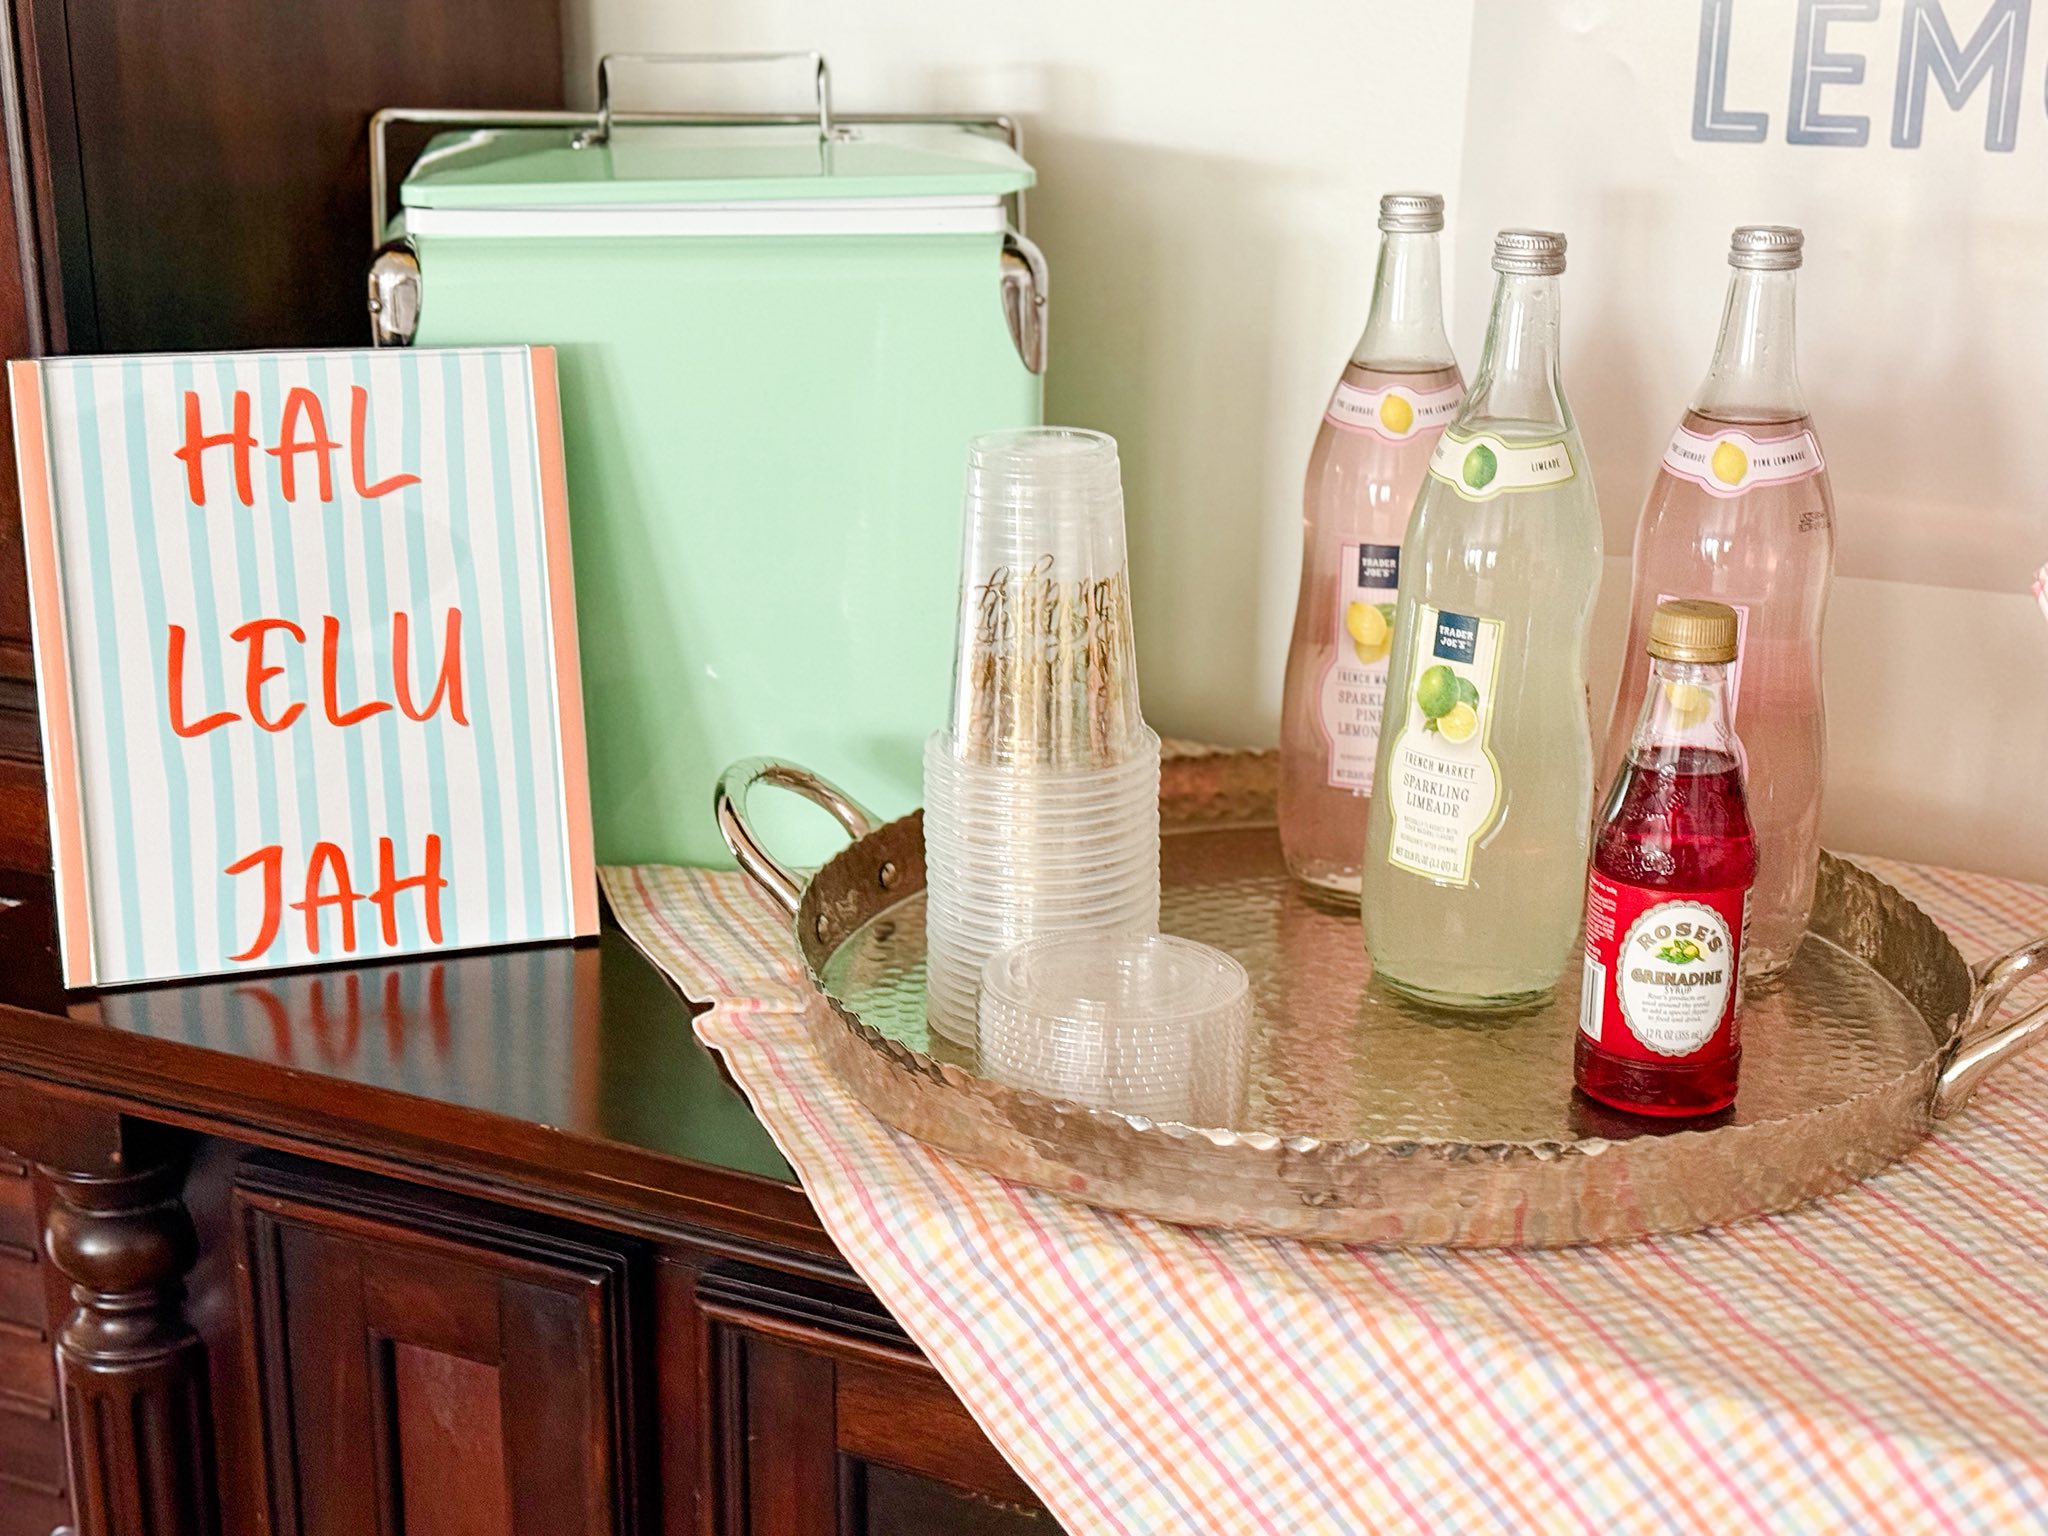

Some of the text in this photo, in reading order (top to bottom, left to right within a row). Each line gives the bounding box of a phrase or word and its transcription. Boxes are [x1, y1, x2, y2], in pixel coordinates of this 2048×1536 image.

[1691, 0, 2048, 152] LEM
[175, 385, 422, 507] HAL
[1531, 458, 1560, 472] LIMEADE
[1753, 459, 1771, 468] PINK
[1774, 451, 1806, 466] LEMONADE
[1362, 557, 1397, 568] TRADER
[1364, 568, 1390, 578] JOE'S
[1439, 625, 1474, 640] TRADER
[1440, 636, 1466, 650] JOE'S
[167, 607, 470, 738] LELU
[1338, 671, 1370, 683] FRENCH
[1405, 751, 1475, 779] FRENCH MARKET
[1403, 772, 1469, 802] SPARKLING
[1406, 791, 1460, 818] LIMEADE
[224, 834, 449, 962] JAH
[1637, 923, 1723, 952] ROSE'S
[1631, 968, 1722, 986] GRENADINE
[1664, 985, 1692, 995] SYRUP
[1646, 1028, 1654, 1039] 12
[1655, 1029, 1663, 1040] FL
[1664, 1030, 1674, 1040] OZ
